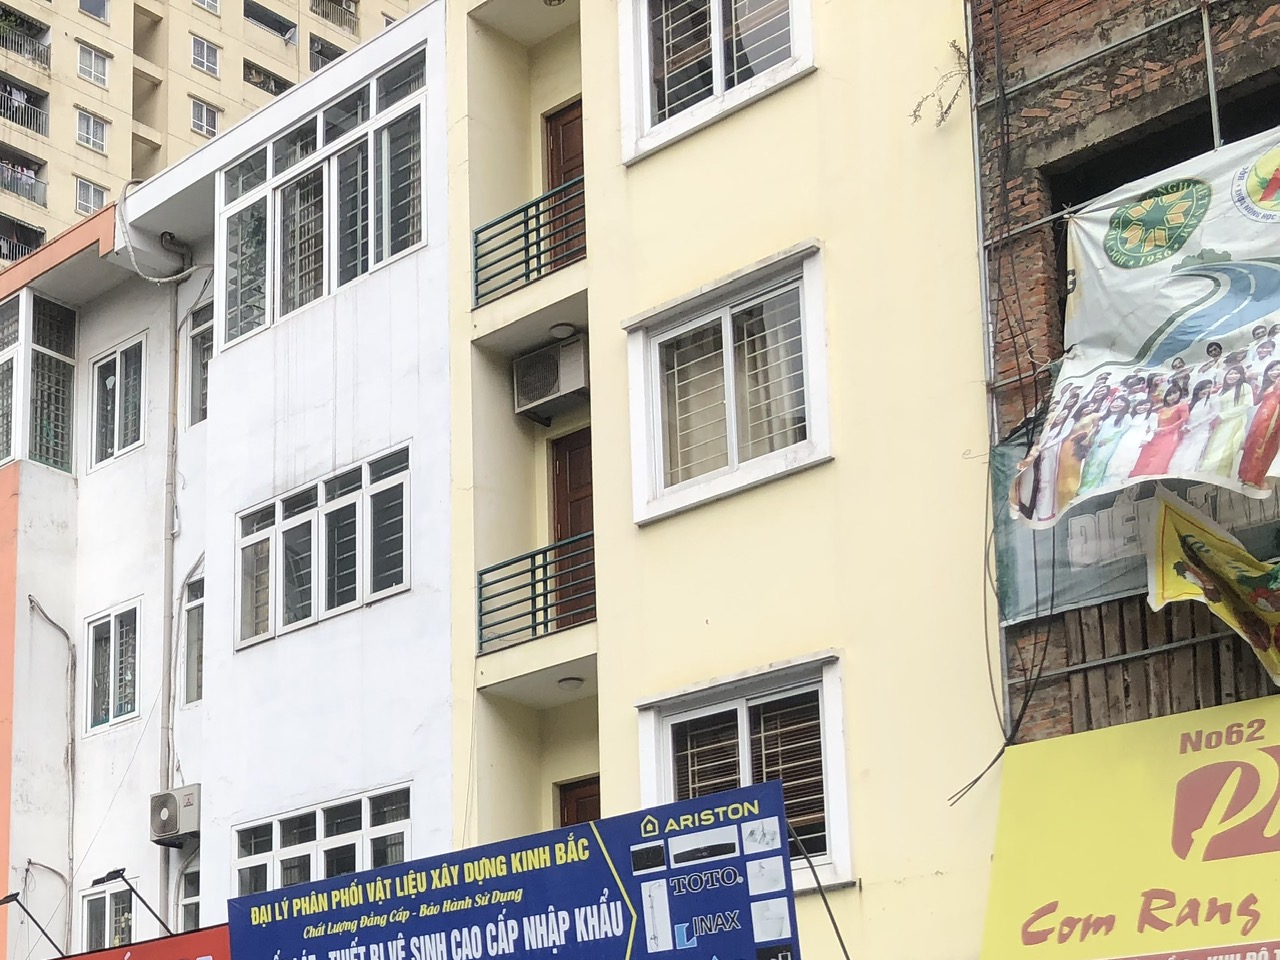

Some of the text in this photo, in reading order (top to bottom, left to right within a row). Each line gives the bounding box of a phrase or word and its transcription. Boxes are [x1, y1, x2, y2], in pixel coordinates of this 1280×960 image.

[1139, 250, 1172, 266] 1956
[1179, 718, 1266, 755] No62
[664, 799, 760, 834] ARISTON
[250, 831, 590, 928] ĐẠI LÝ PHÂN PHỐI VẬT LIỆU XÂY DỰNG KINH BẮC
[670, 867, 740, 896] TOTO
[303, 887, 524, 939] Chất Cấp Bảo Hành Sử Dụng
[485, 908, 519, 957] CẤP
[522, 905, 570, 954] NHẬP
[574, 887, 625, 943] KHẨU
[692, 910, 741, 937] INAX
[1136, 887, 1261, 937] Rang
